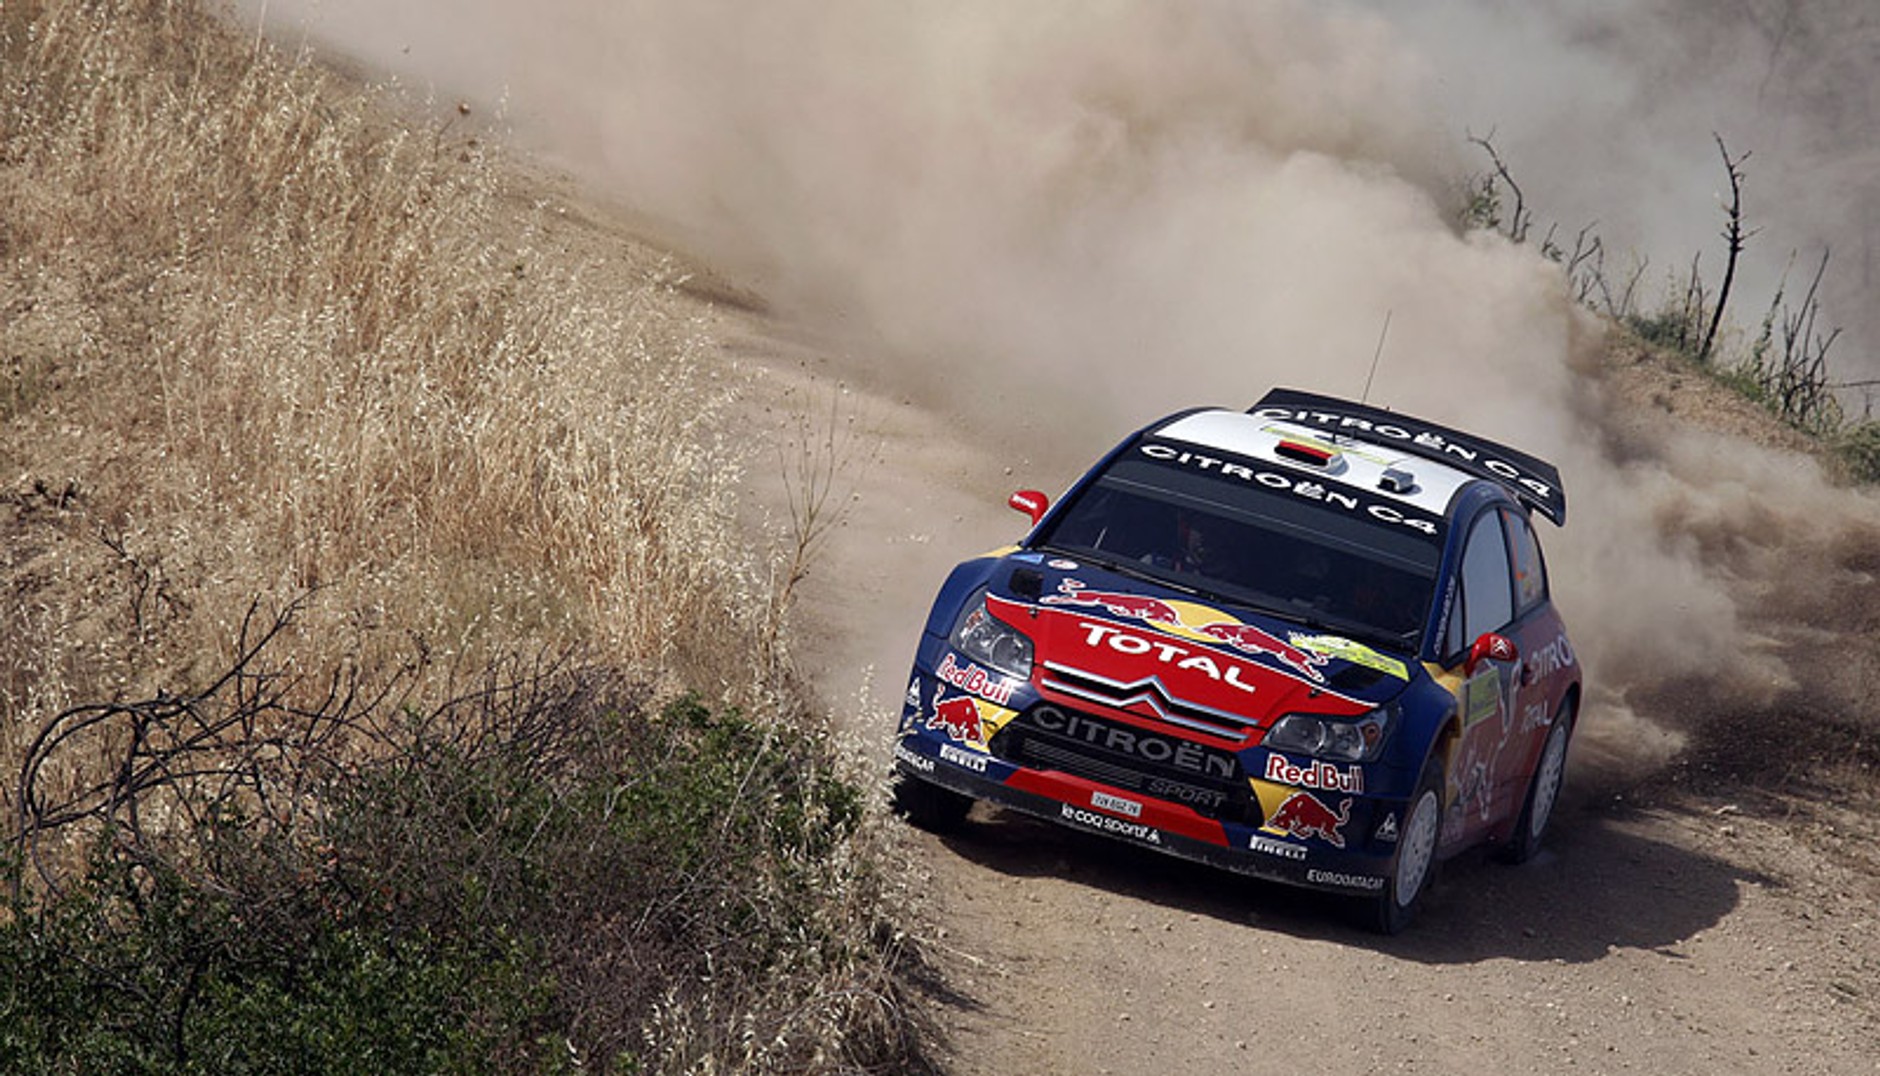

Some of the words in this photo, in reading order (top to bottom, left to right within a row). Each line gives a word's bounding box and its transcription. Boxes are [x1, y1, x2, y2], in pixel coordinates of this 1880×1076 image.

[1253, 408, 1477, 461] CITROËN
[1485, 460, 1551, 498] C4
[1141, 445, 1358, 509] CITROËN
[1367, 505, 1438, 534] C4
[1079, 622, 1256, 693] TOTAL
[1034, 705, 1235, 778] CITROËN
[1062, 803, 1074, 819] le
[1074, 810, 1103, 828] coq
[1104, 818, 1148, 838] sportif
[1148, 779, 1227, 807] SPORT
[1249, 834, 1308, 860] PIRELLI
